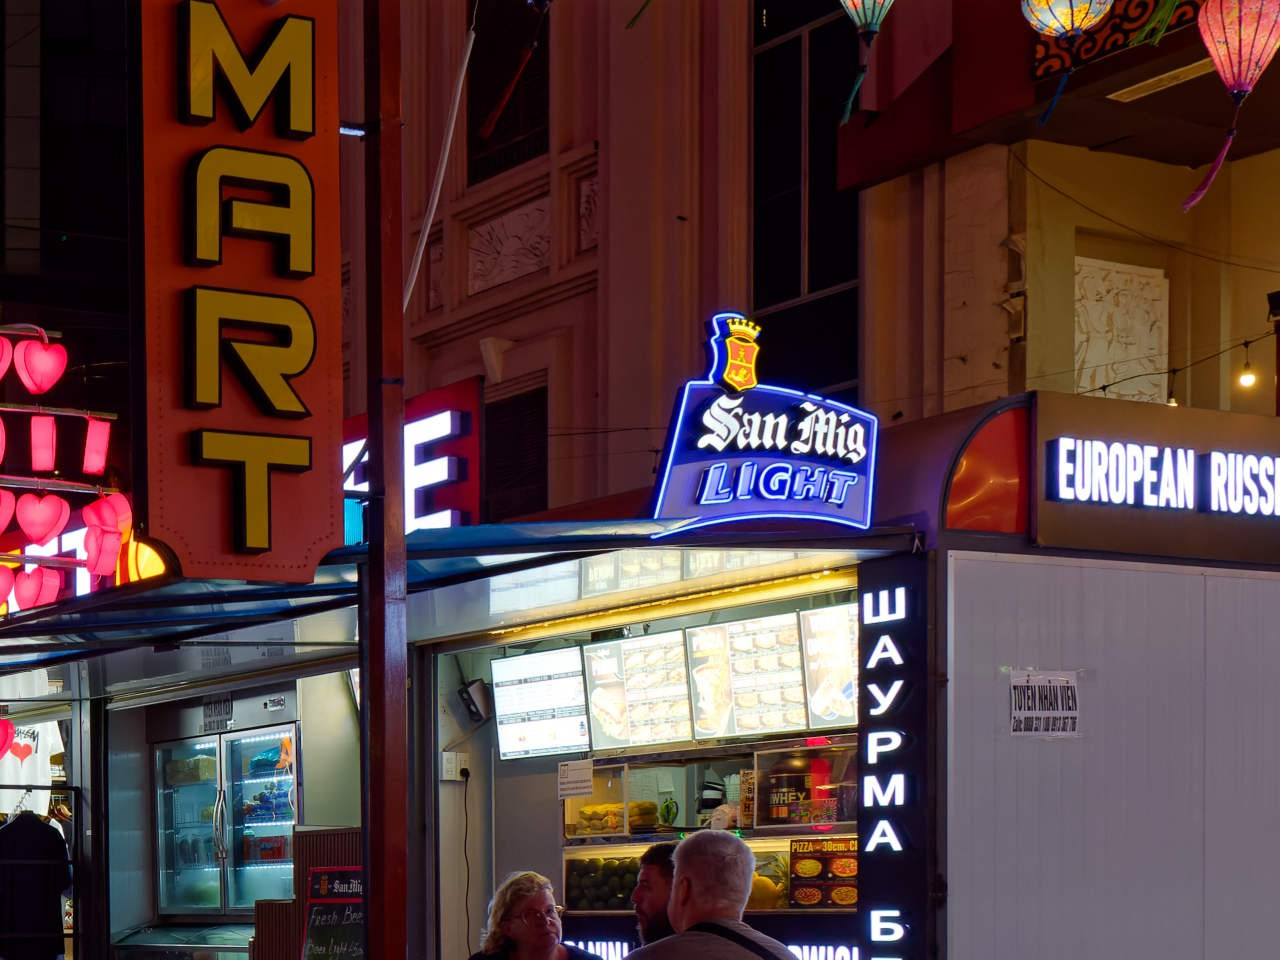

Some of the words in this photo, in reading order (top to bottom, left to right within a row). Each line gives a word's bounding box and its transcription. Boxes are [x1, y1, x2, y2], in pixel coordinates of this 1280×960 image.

[188, 0, 316, 552] MART
[697, 394, 788, 453] San
[790, 402, 866, 463] Mig
[700, 462, 858, 505] LIGHT
[1058, 437, 1195, 510] EUROPEAN
[862, 586, 906, 853] ШАУРМА
[769, 791, 807, 805] WHEY
